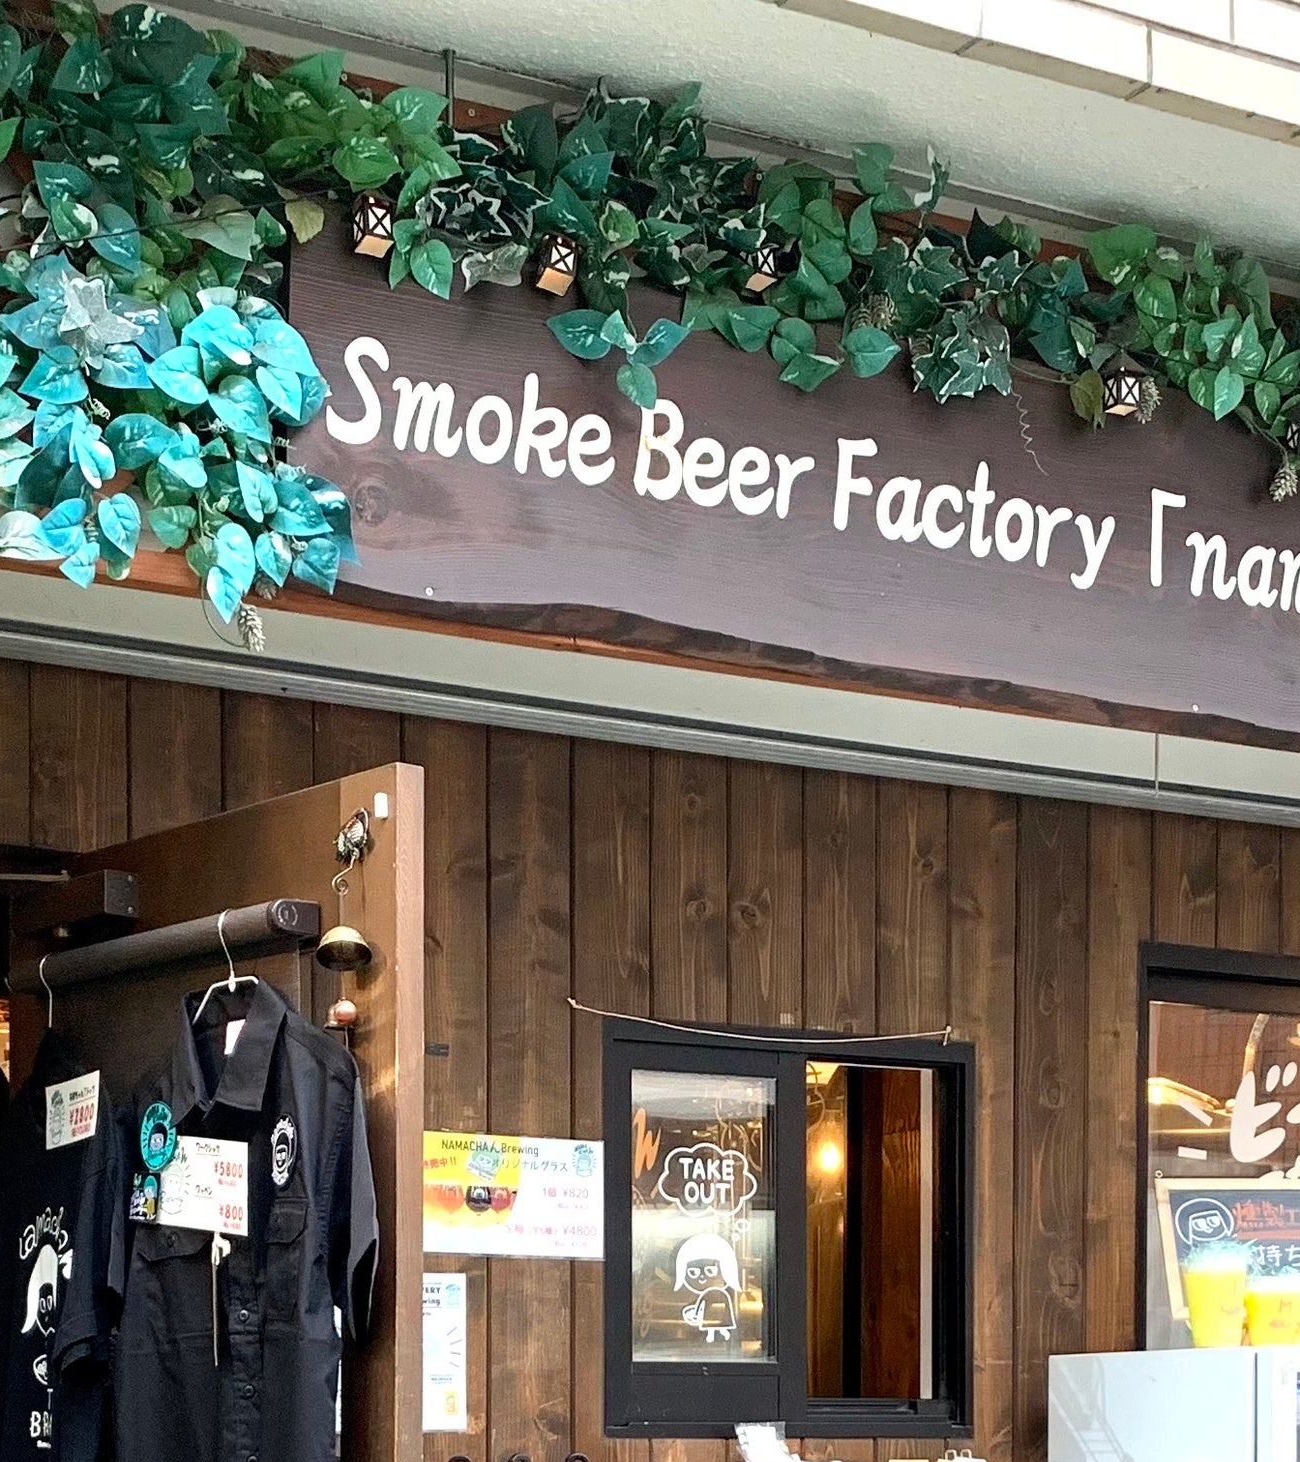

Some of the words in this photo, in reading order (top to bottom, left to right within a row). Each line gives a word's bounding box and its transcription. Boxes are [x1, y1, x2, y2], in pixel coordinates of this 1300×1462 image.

[325, 333, 614, 487] Smoke
[637, 398, 817, 519] Beer
[833, 435, 1117, 588] Factory
[213, 1160, 243, 1179] ¥5800
[678, 1157, 735, 1181] TAKE
[684, 1182, 732, 1204] OUT
[219, 1204, 243, 1221] ¥800
